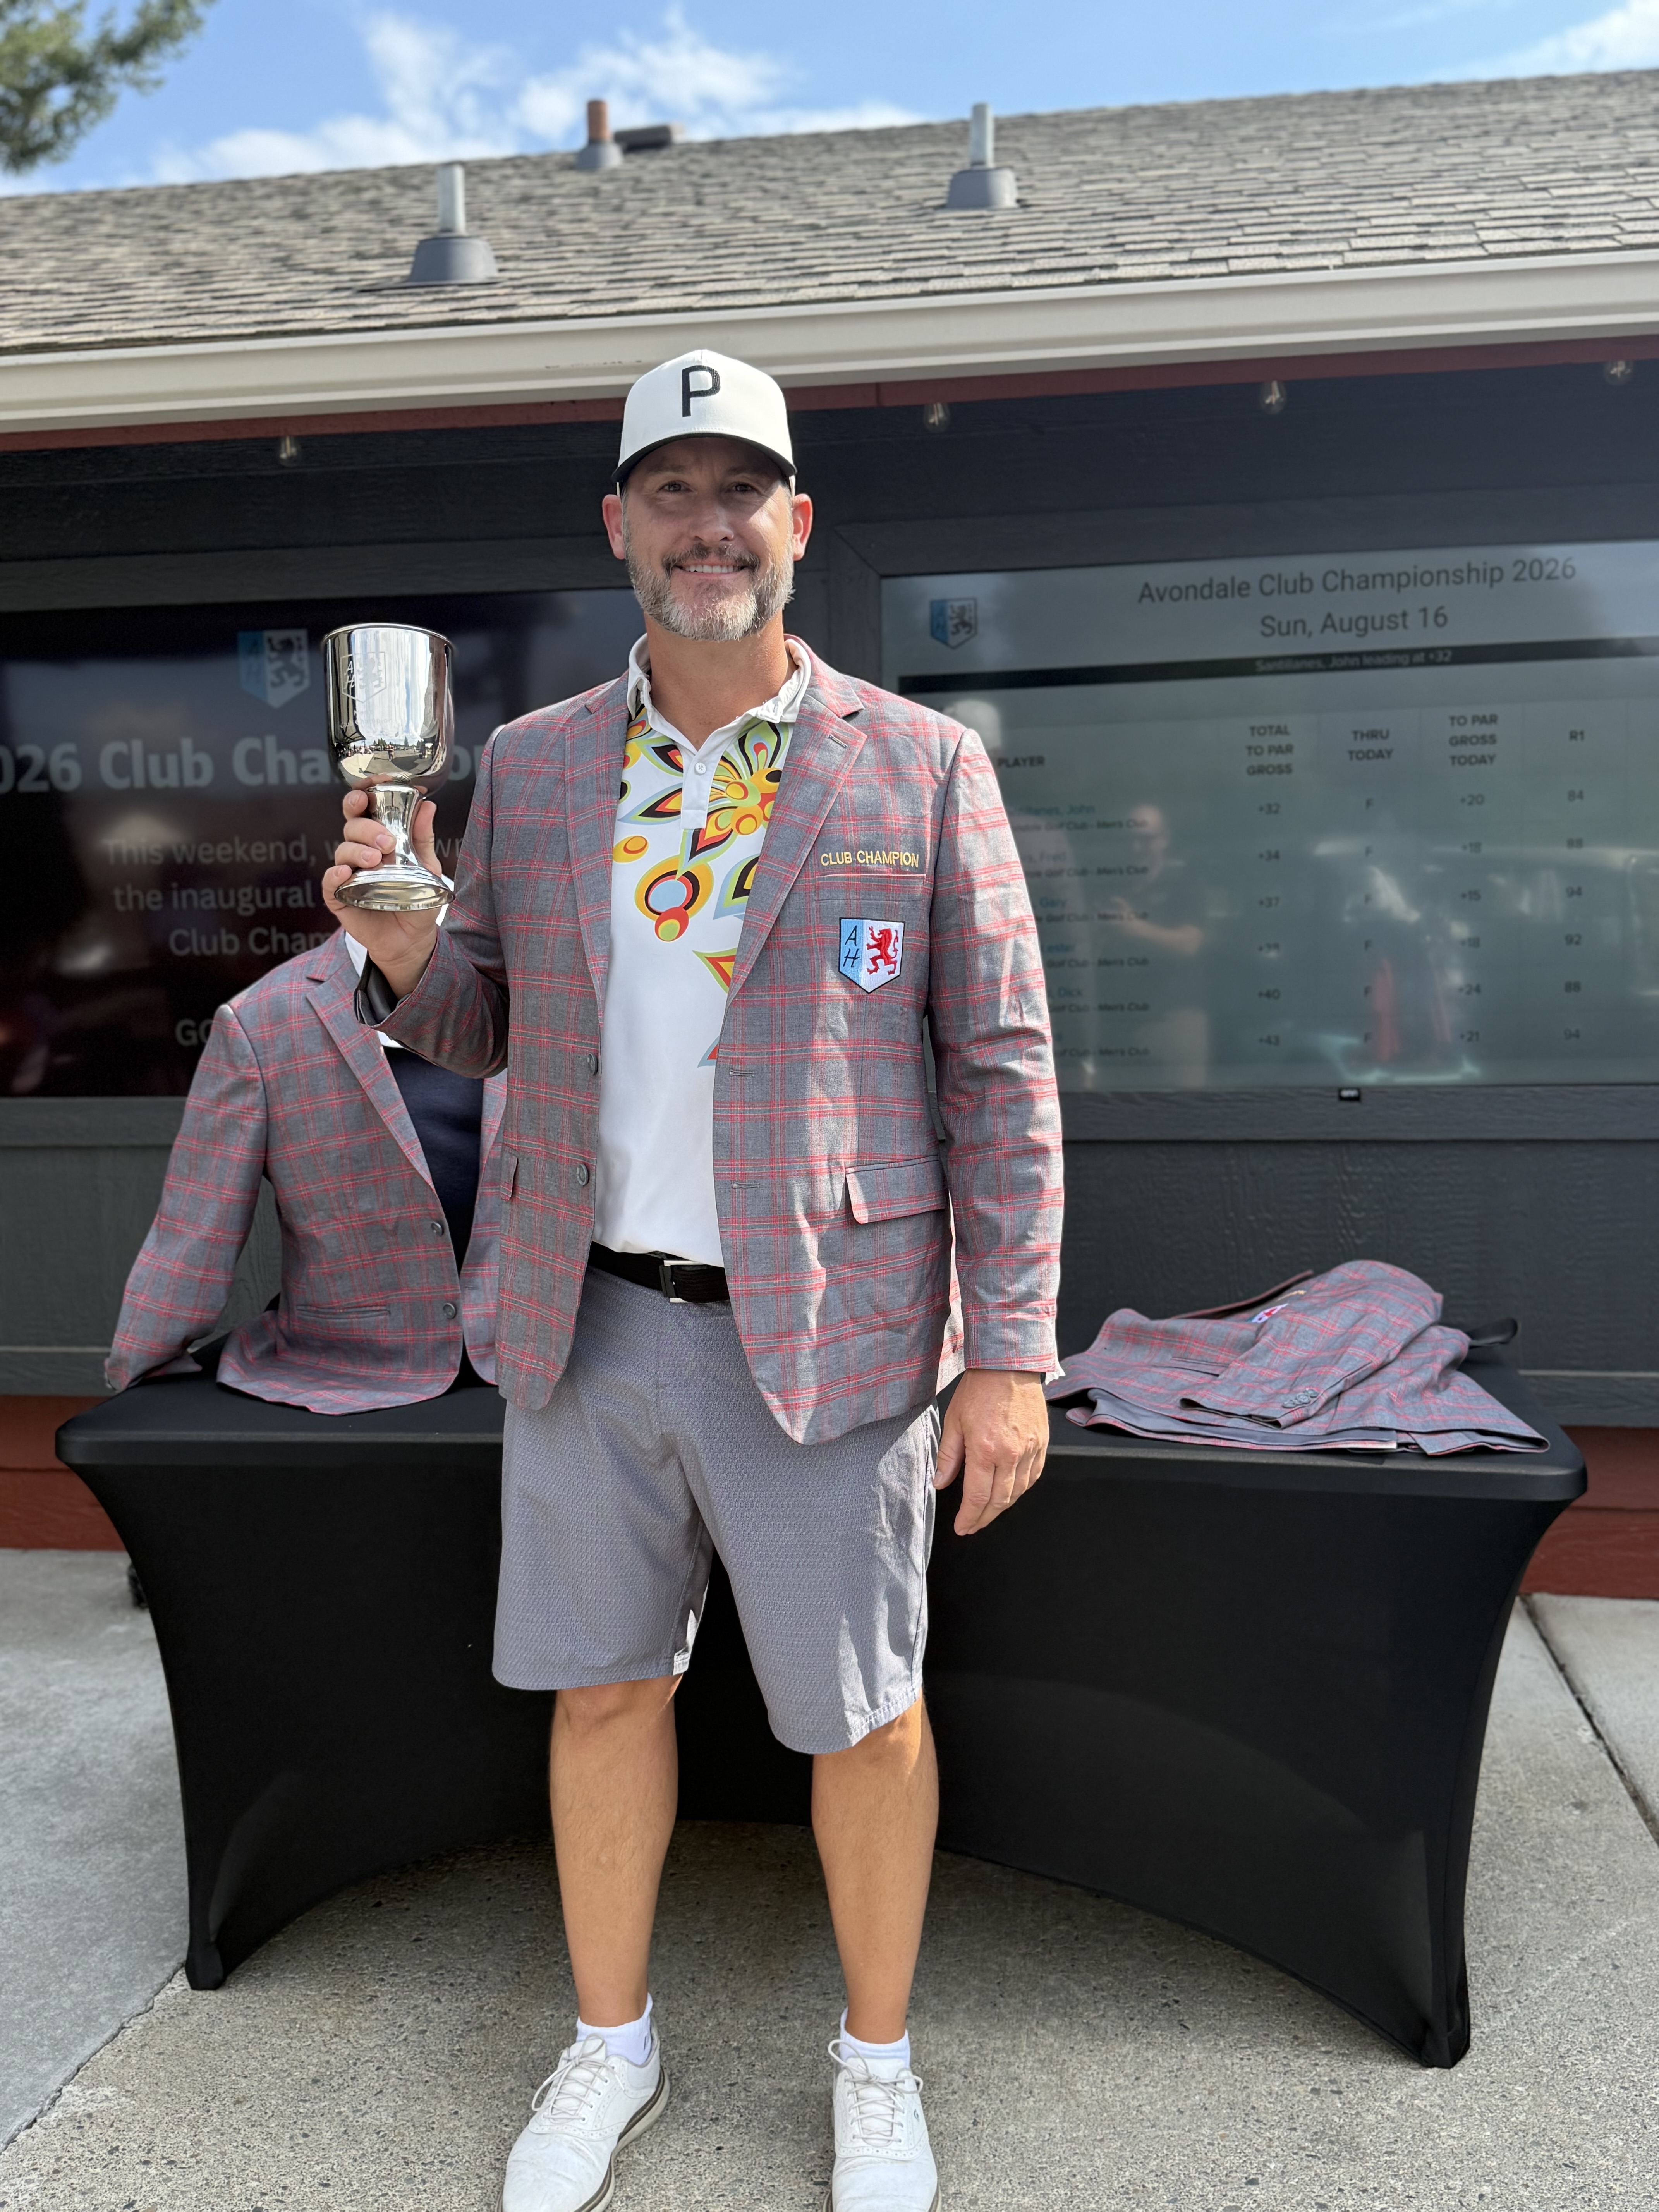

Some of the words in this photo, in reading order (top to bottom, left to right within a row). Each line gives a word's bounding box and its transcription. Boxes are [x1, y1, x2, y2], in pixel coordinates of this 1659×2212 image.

[682, 365, 721, 417] P
[1137, 576, 1251, 604] Avondale
[1258, 572, 1314, 597] Club
[1321, 560, 1504, 594] Championship
[1512, 557, 1576, 582] 2026
[1259, 615, 1313, 639] Sun,
[1319, 609, 1409, 639] August
[1418, 605, 1449, 629] 16
[1329, 655, 1360, 668] John
[1362, 653, 1409, 666] leading
[1412, 652, 1424, 663] at
[1429, 650, 1452, 662] +32
[1448, 714, 1468, 727] TO
[1470, 713, 1499, 726] PAR
[1249, 724, 1291, 737] TOTAL
[1350, 728, 1391, 742] THRU
[1568, 728, 1585, 743] R1
[1448, 733, 1498, 748] GROSS
[1245, 745, 1265, 757] TO
[1267, 743, 1295, 756] PAR
[1346, 747, 1395, 762] TODAY
[99, 736, 216, 789] Club
[996, 755, 1046, 769] PLAYER
[1448, 752, 1498, 768] TODAY
[1245, 762, 1293, 777] GROSS
[1460, 793, 1486, 807] +20
[1566, 789, 1585, 803] 84
[1257, 802, 1281, 815] +32
[1365, 797, 1375, 811] F
[103, 839, 165, 866] This
[172, 833, 316, 867] weekend,
[1257, 849, 1281, 862] +34
[1365, 845, 1373, 857] F
[820, 852, 852, 867] CLUB
[856, 850, 919, 868] CHAMPION
[113, 884, 164, 912] the
[171, 880, 316, 917] inaugural
[1364, 893, 1372, 905] F
[1565, 885, 1583, 899] 94
[1258, 896, 1281, 909] +37
[169, 927, 240, 957] Club
[248, 927, 333, 956] Cham
[845, 925, 857, 946] A
[1564, 933, 1582, 946] 92
[1364, 939, 1373, 952] F
[843, 949, 860, 967] H
[1364, 985, 1372, 998] F
[1458, 982, 1482, 996] +24
[1564, 980, 1582, 993] 88
[1258, 988, 1281, 1000] +40
[1258, 1034, 1281, 1046] +43
[1364, 1032, 1372, 1044] F
[1460, 1030, 1480, 1042] +21
[1563, 1028, 1581, 1041] 94
